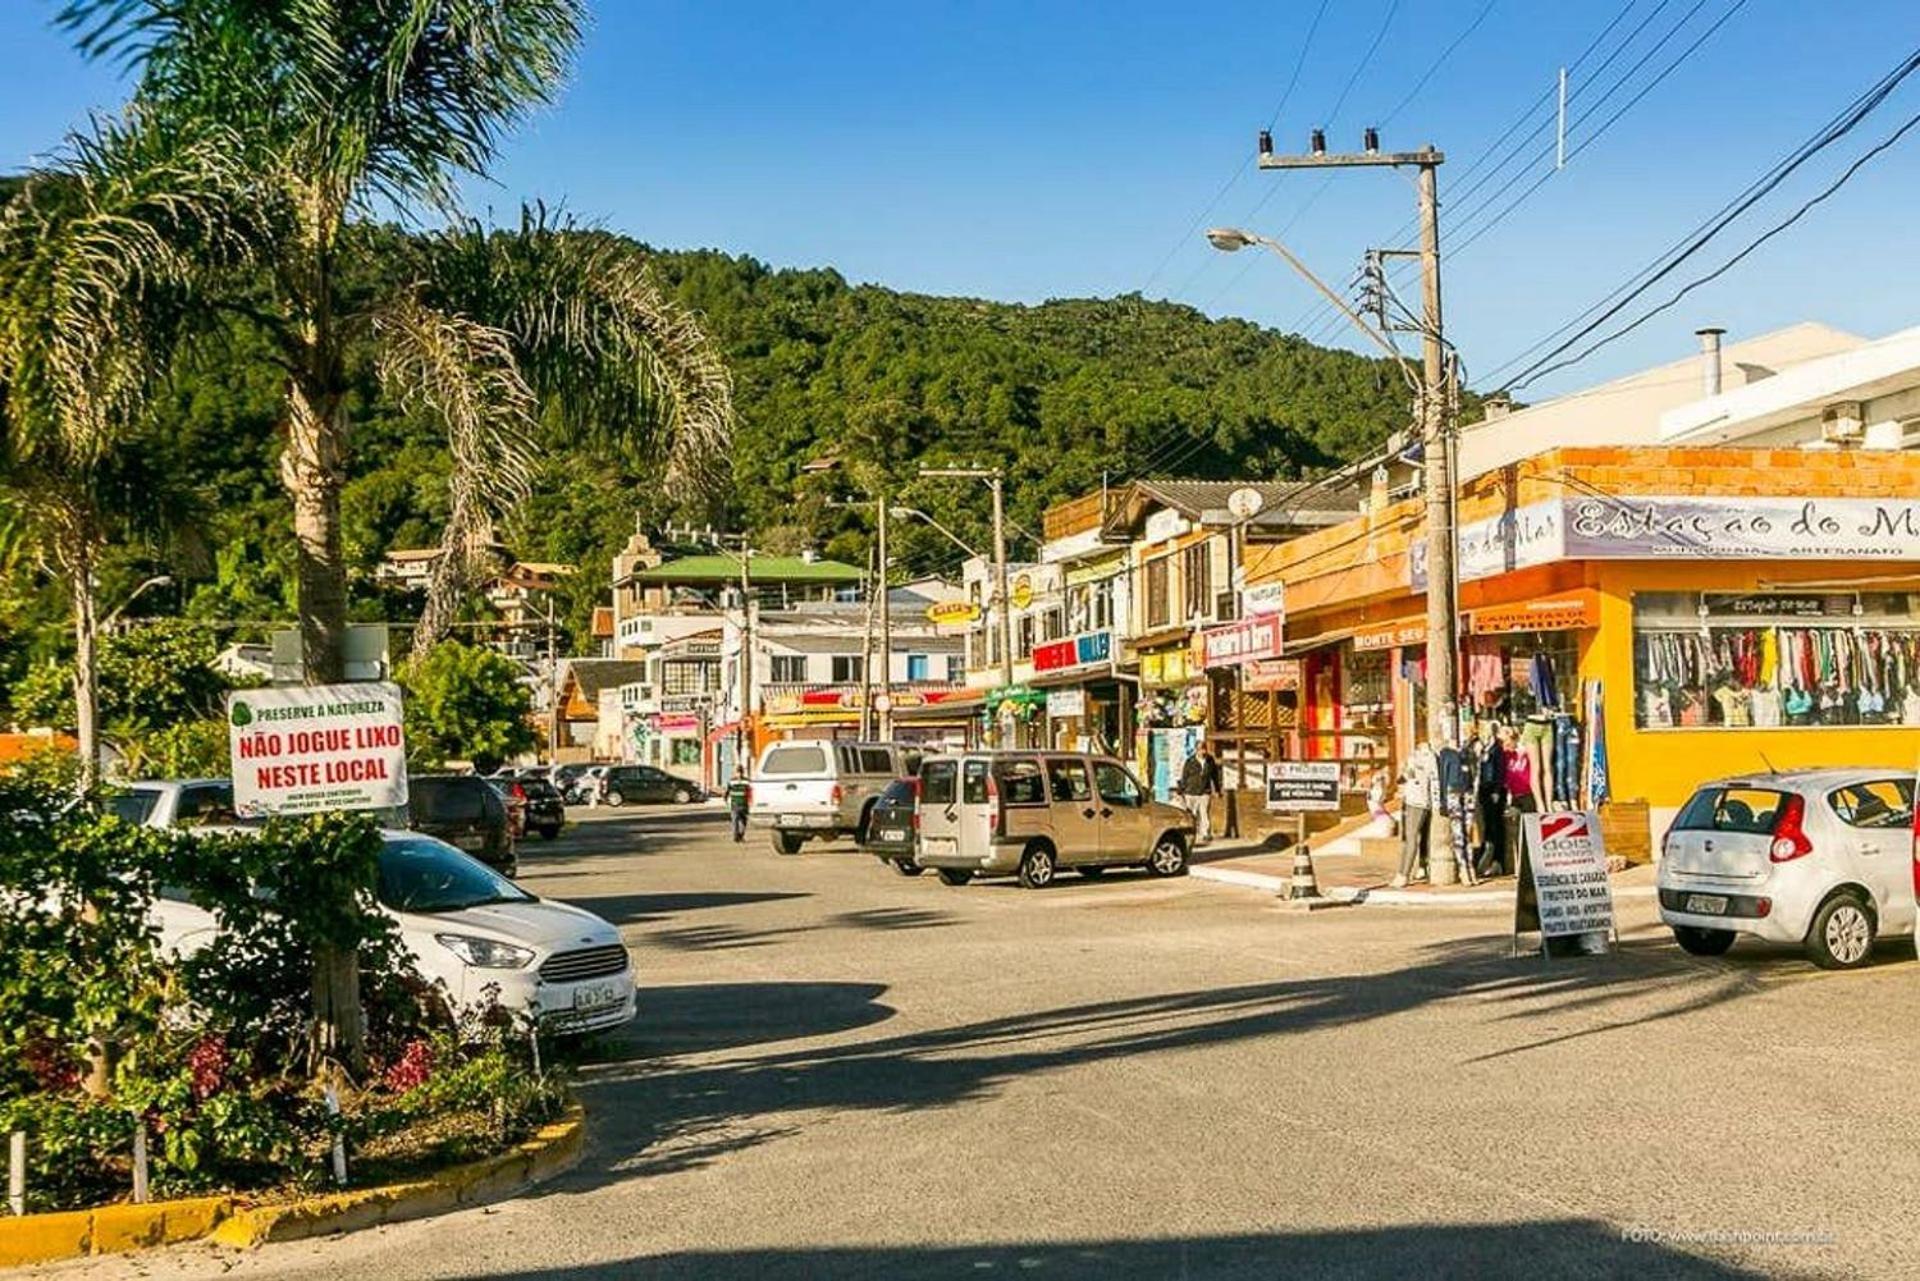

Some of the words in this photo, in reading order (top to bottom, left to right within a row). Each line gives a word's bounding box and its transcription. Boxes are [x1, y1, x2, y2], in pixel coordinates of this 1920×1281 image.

[1573, 501, 1772, 542] Estação
[1790, 501, 1840, 537] do
[256, 707, 315, 722] PRESERVE
[316, 707, 326, 718] A
[326, 700, 386, 717] NATUREZA
[239, 730, 282, 759] NÃO
[287, 729, 351, 755] JOGUE
[356, 725, 400, 750] LIXO
[257, 763, 321, 790] NESTE
[324, 757, 388, 783] LOCAL
[1542, 838, 1592, 850] dois
